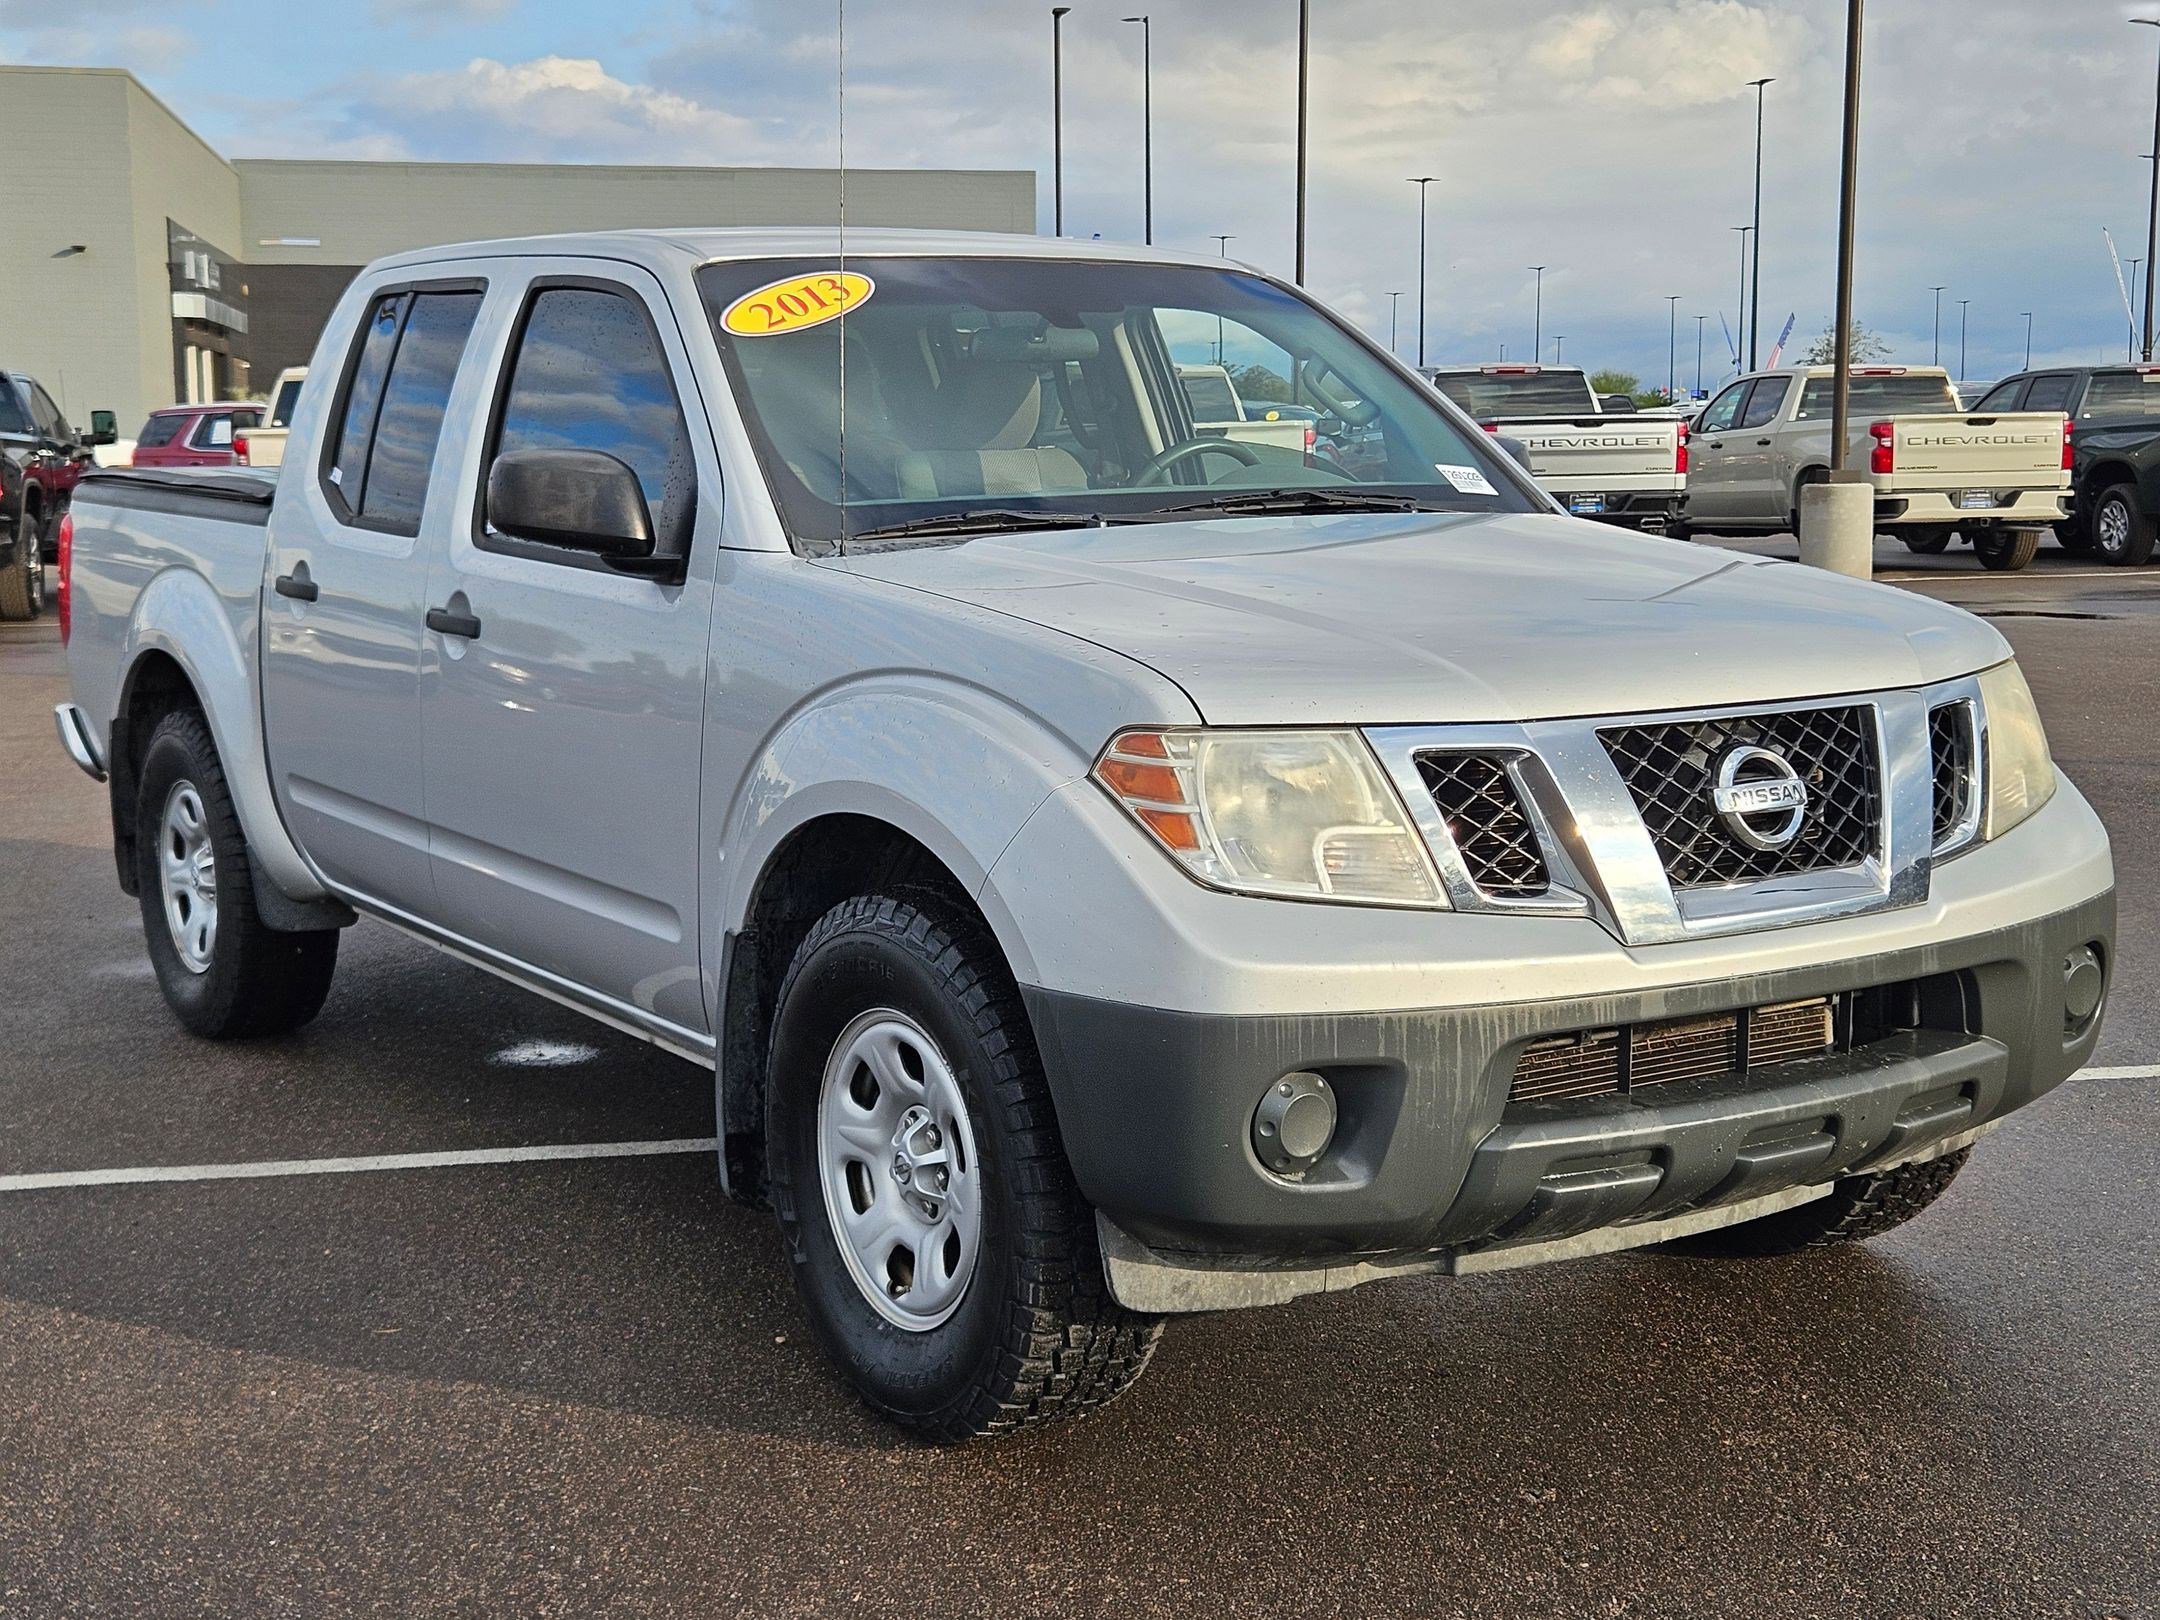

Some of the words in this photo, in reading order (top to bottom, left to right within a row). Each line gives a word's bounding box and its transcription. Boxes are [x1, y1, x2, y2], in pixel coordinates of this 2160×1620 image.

[748, 278, 851, 329] 2013
[1522, 436, 1667, 448] HEVROLET
[1907, 434, 2054, 446] CHEVROLET
[1729, 784, 1804, 808] NISSAN
